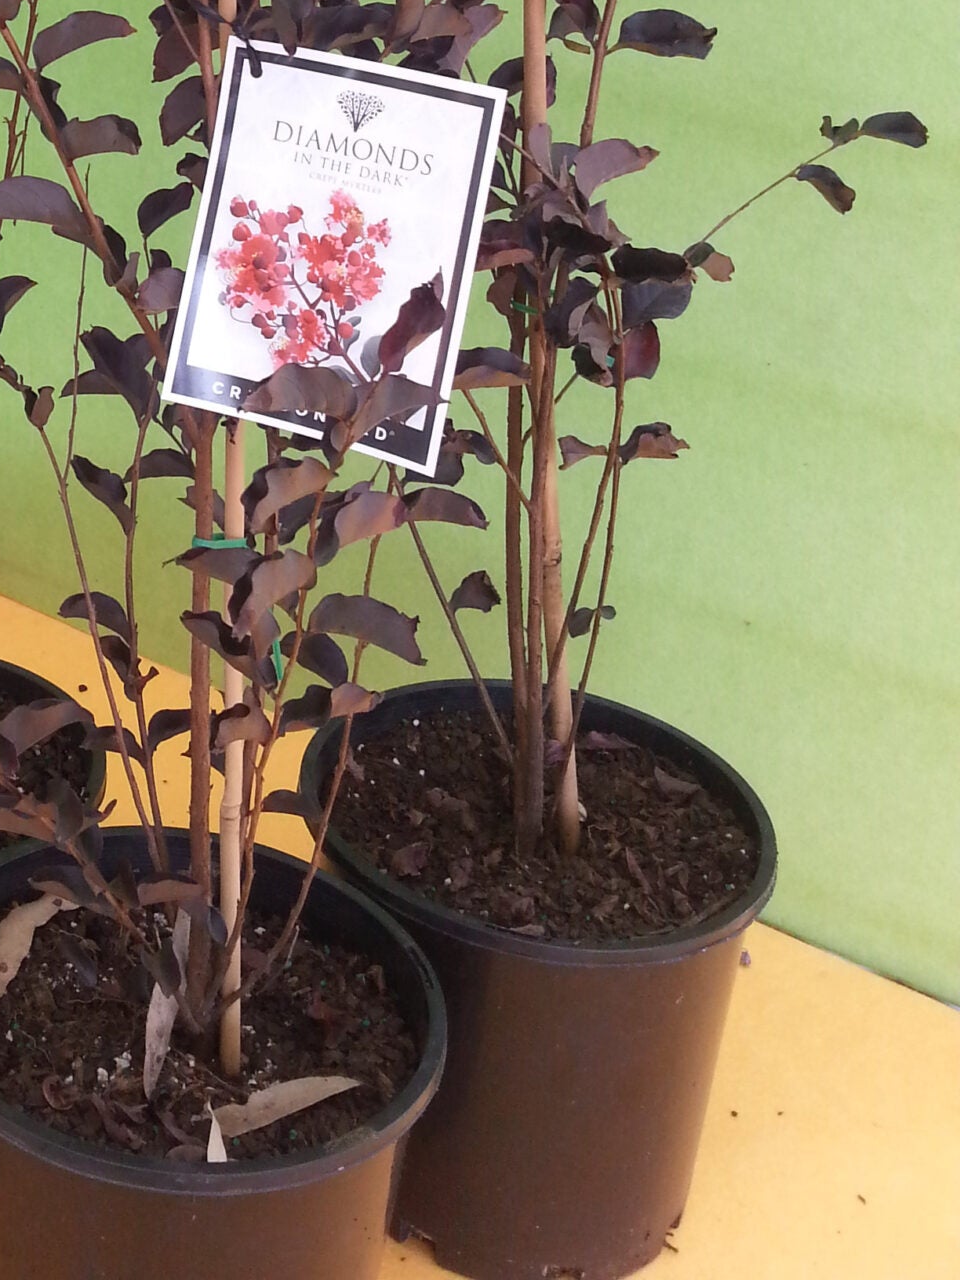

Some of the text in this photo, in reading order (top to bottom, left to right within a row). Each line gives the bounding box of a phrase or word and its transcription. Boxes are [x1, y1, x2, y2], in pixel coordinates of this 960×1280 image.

[273, 120, 434, 176] DIAMONDS
[294, 151, 403, 188] IN THE DARK
